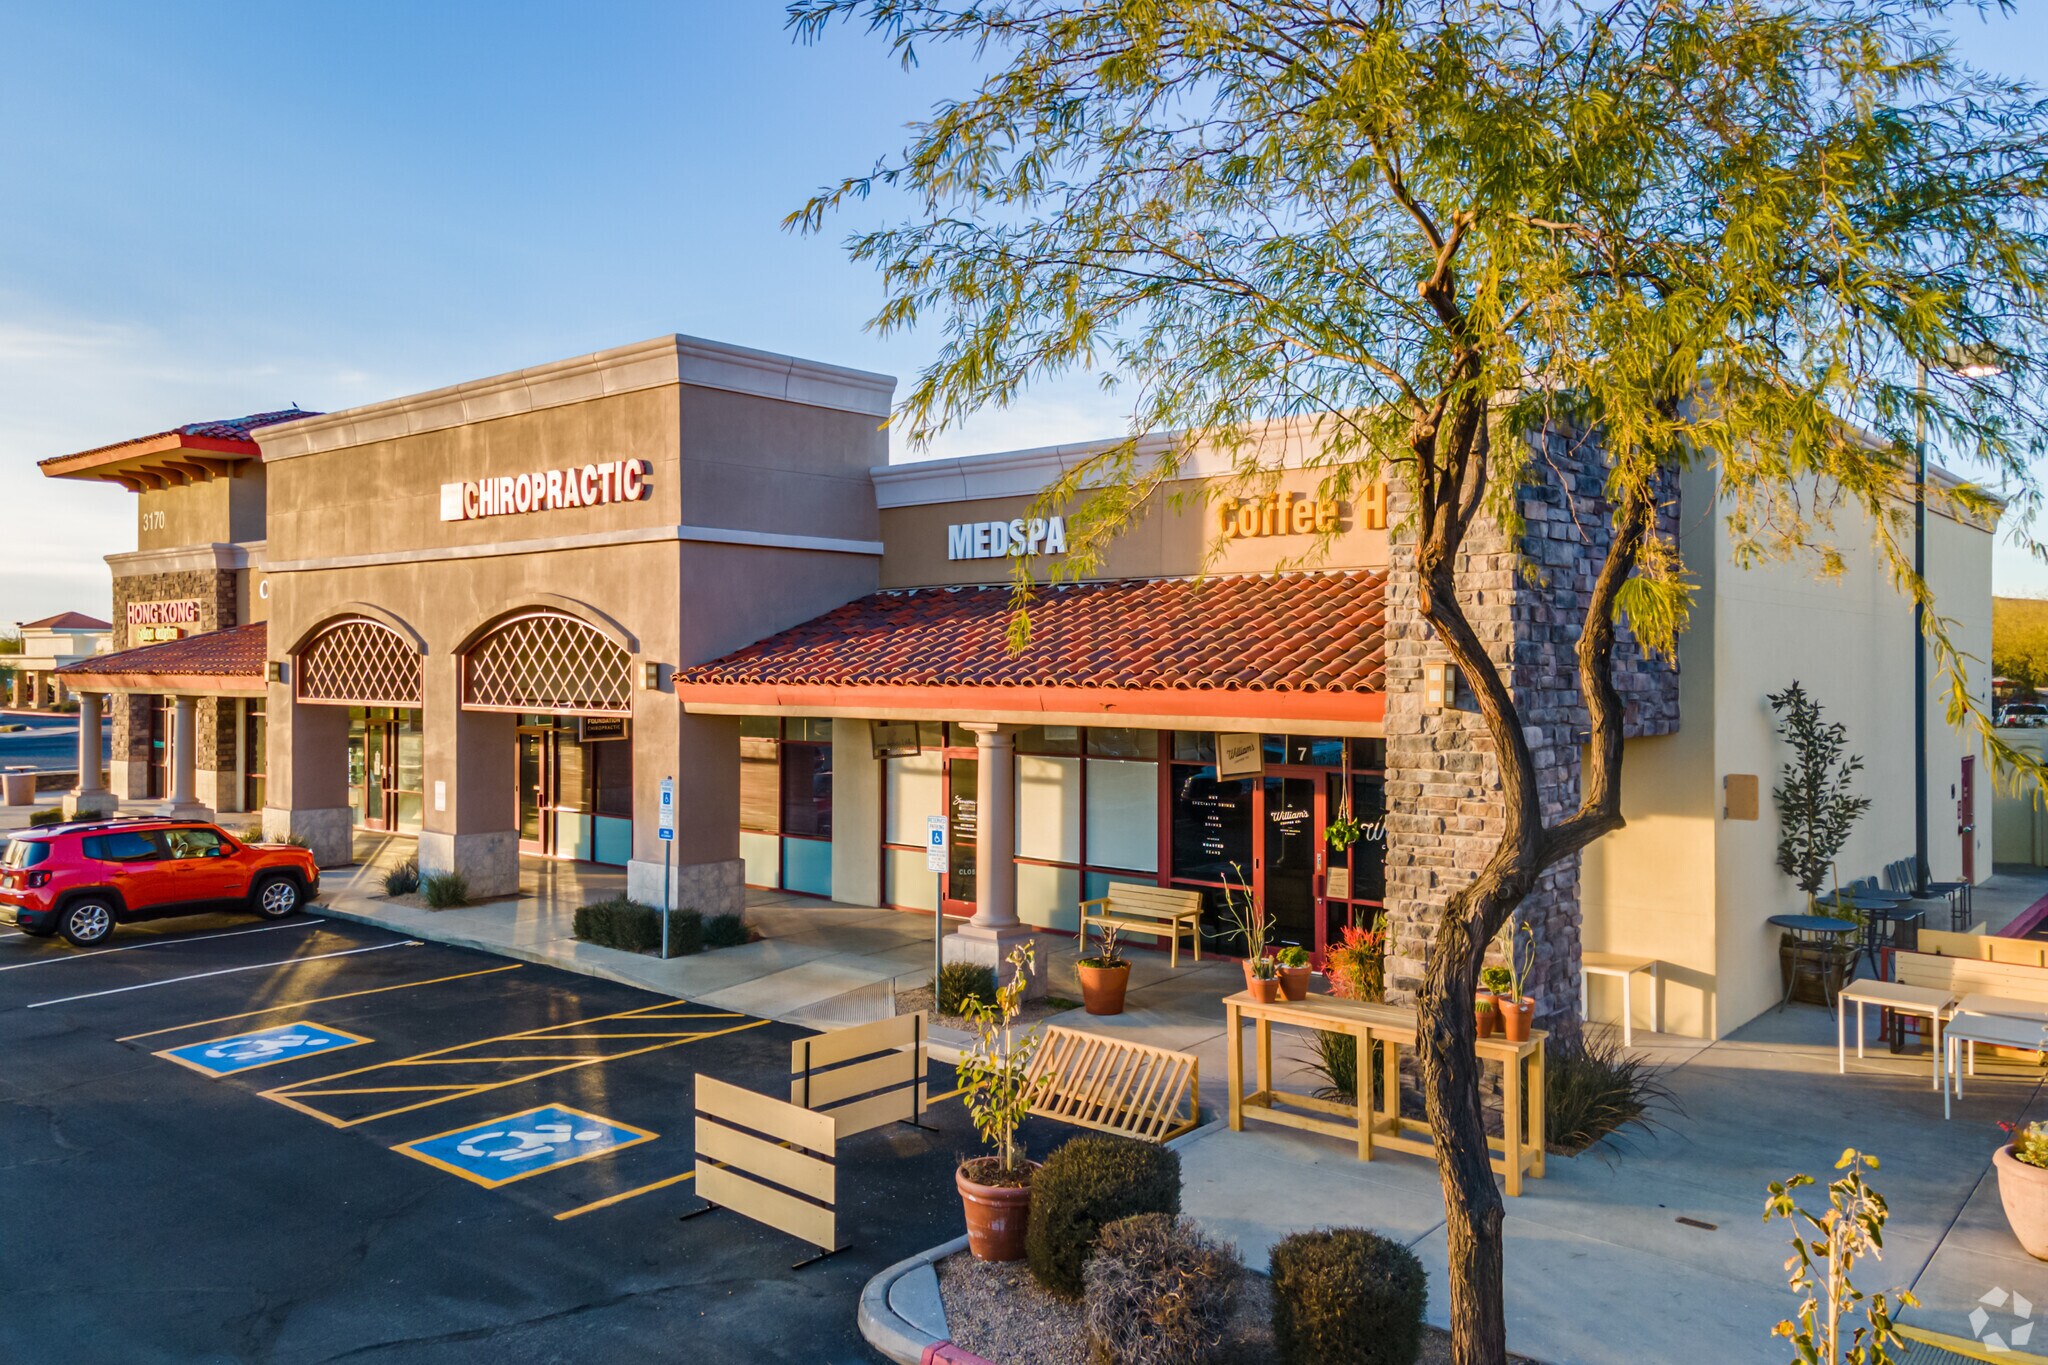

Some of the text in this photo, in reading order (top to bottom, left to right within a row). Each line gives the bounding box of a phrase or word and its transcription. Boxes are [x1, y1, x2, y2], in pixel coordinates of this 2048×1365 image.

[464, 457, 647, 520] CHIROPRACTIC
[143, 510, 165, 531] 3170
[1218, 490, 1341, 539] Coffee
[948, 515, 1067, 560] MEDSPA
[127, 600, 195, 624] HONG KONG
[1297, 746, 1307, 761] 7
[1270, 809, 1310, 822] William's
